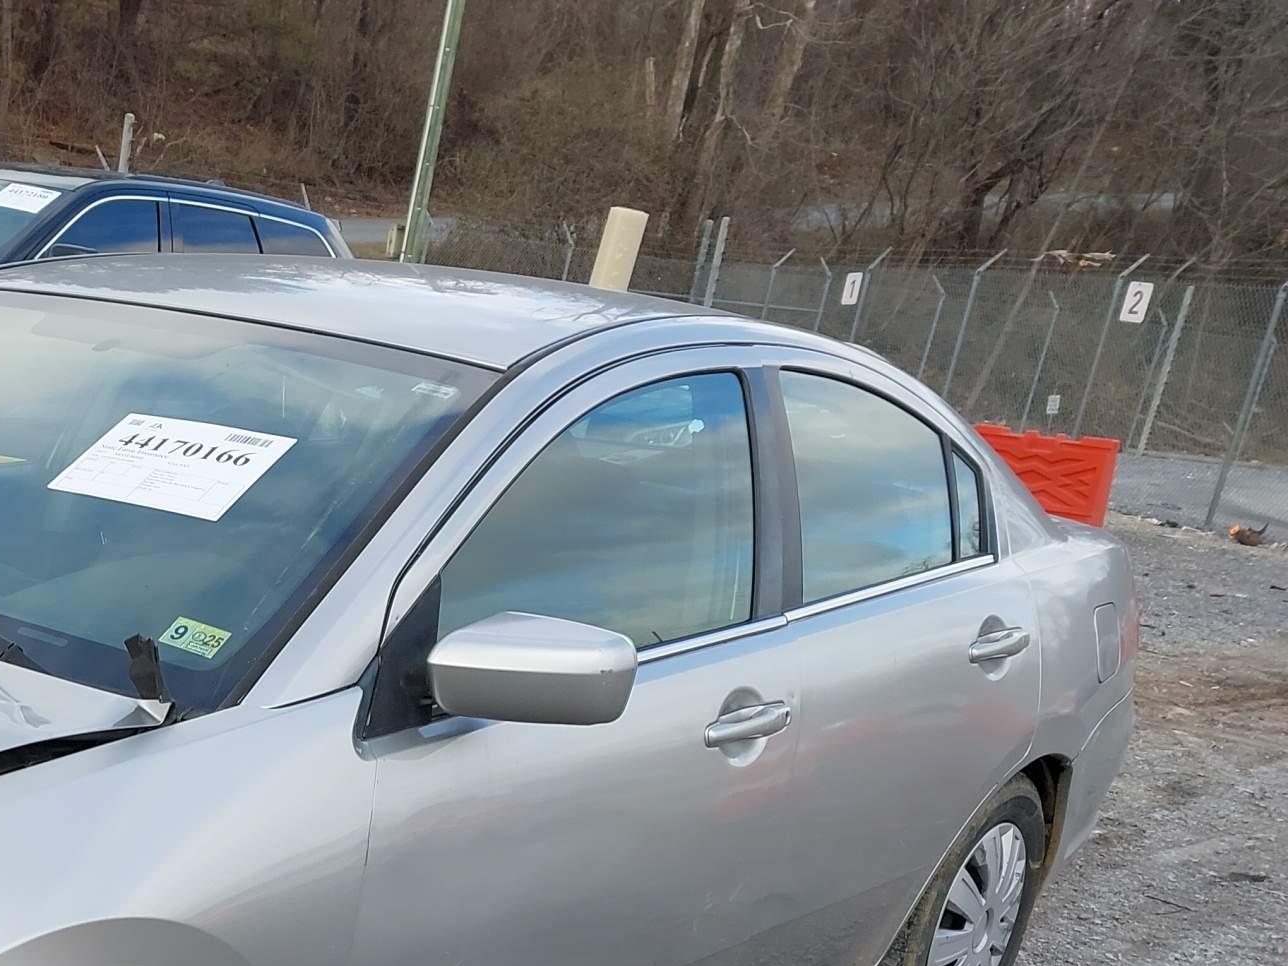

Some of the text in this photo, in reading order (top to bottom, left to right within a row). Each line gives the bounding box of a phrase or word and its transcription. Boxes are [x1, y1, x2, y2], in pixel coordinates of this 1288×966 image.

[848, 279, 857, 299] 1
[1127, 291, 1144, 315] 2
[118, 433, 257, 467] 44170166
[170, 625, 188, 640] 9
[203, 634, 225, 648] 25
